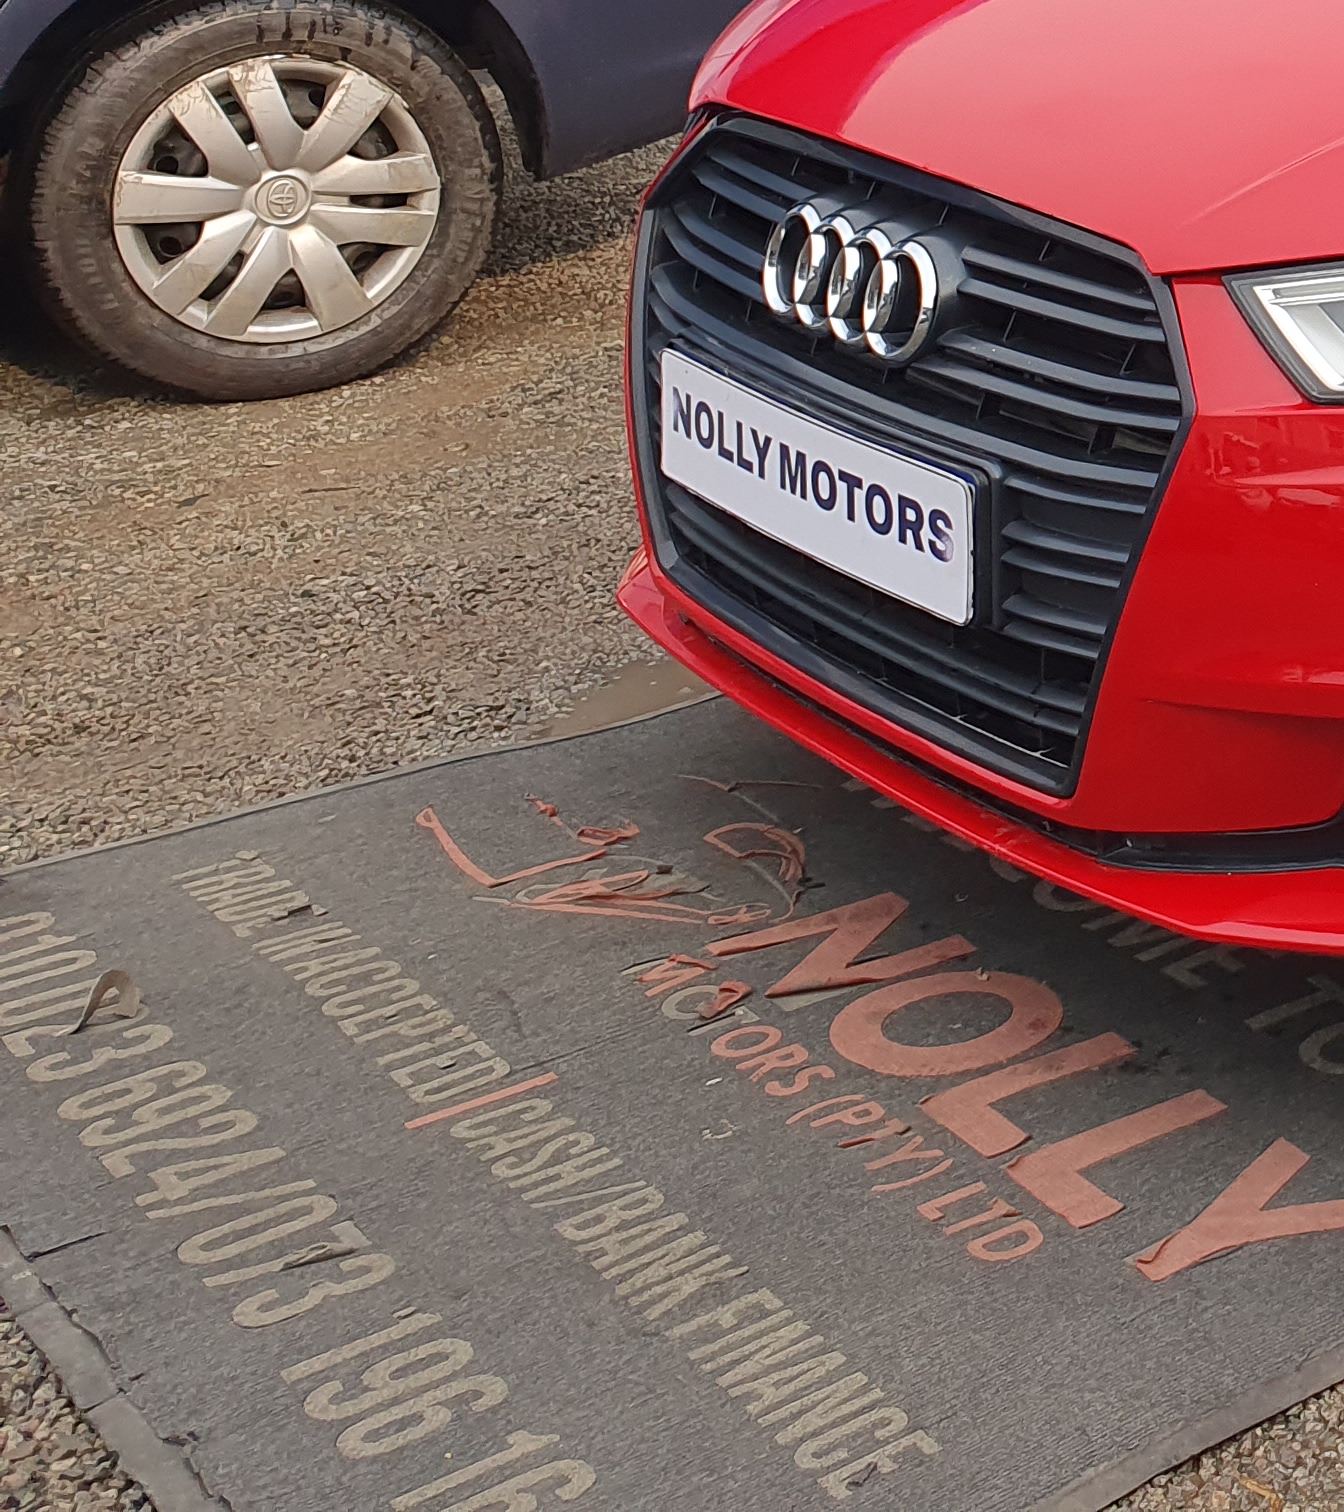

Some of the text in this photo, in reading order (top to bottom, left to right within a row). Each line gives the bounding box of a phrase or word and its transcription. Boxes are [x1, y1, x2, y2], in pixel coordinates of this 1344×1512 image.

[672, 386, 954, 563] NOLLY MOTORS
[171, 850, 328, 937] TRADE
[665, 1286, 943, 1500] FINANCE
[620, 953, 1044, 1262] MOTORS (PTY) LTD
[280, 1306, 509, 1460] 196
